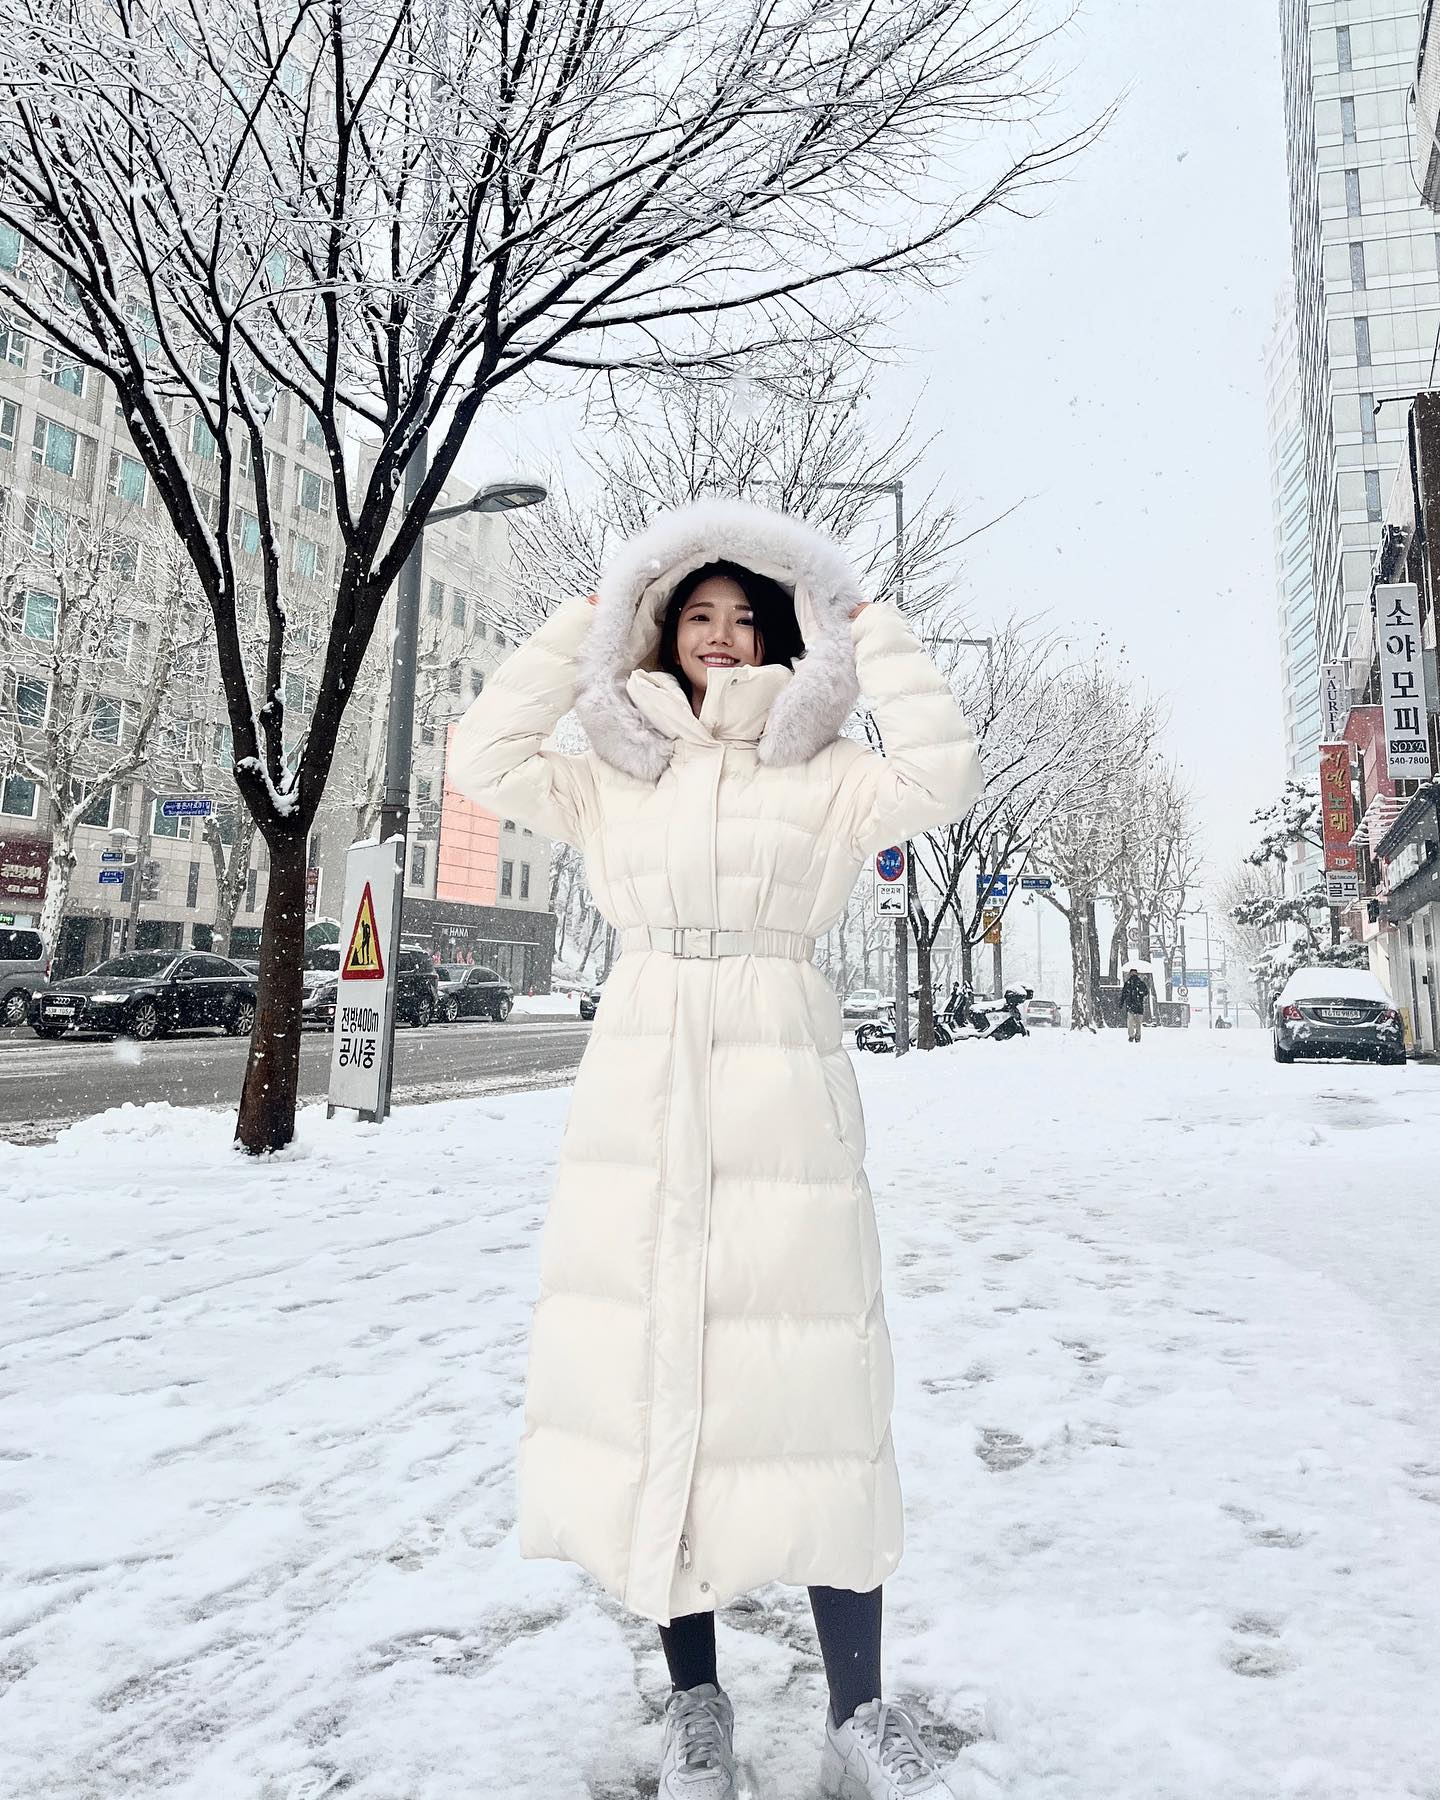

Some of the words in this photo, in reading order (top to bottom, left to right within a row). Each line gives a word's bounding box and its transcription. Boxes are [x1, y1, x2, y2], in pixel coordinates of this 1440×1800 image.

[1385, 598, 1420, 735] 소야모피
[1326, 669, 1338, 733] LAUREL
[1391, 740, 1426, 753] SOYA
[1389, 756, 1430, 765] 540-7800
[1329, 882, 1358, 897] 골프
[449, 927, 469, 937] HANA
[341, 1007, 379, 1033] 전방400m
[339, 1038, 375, 1068] 공사중
